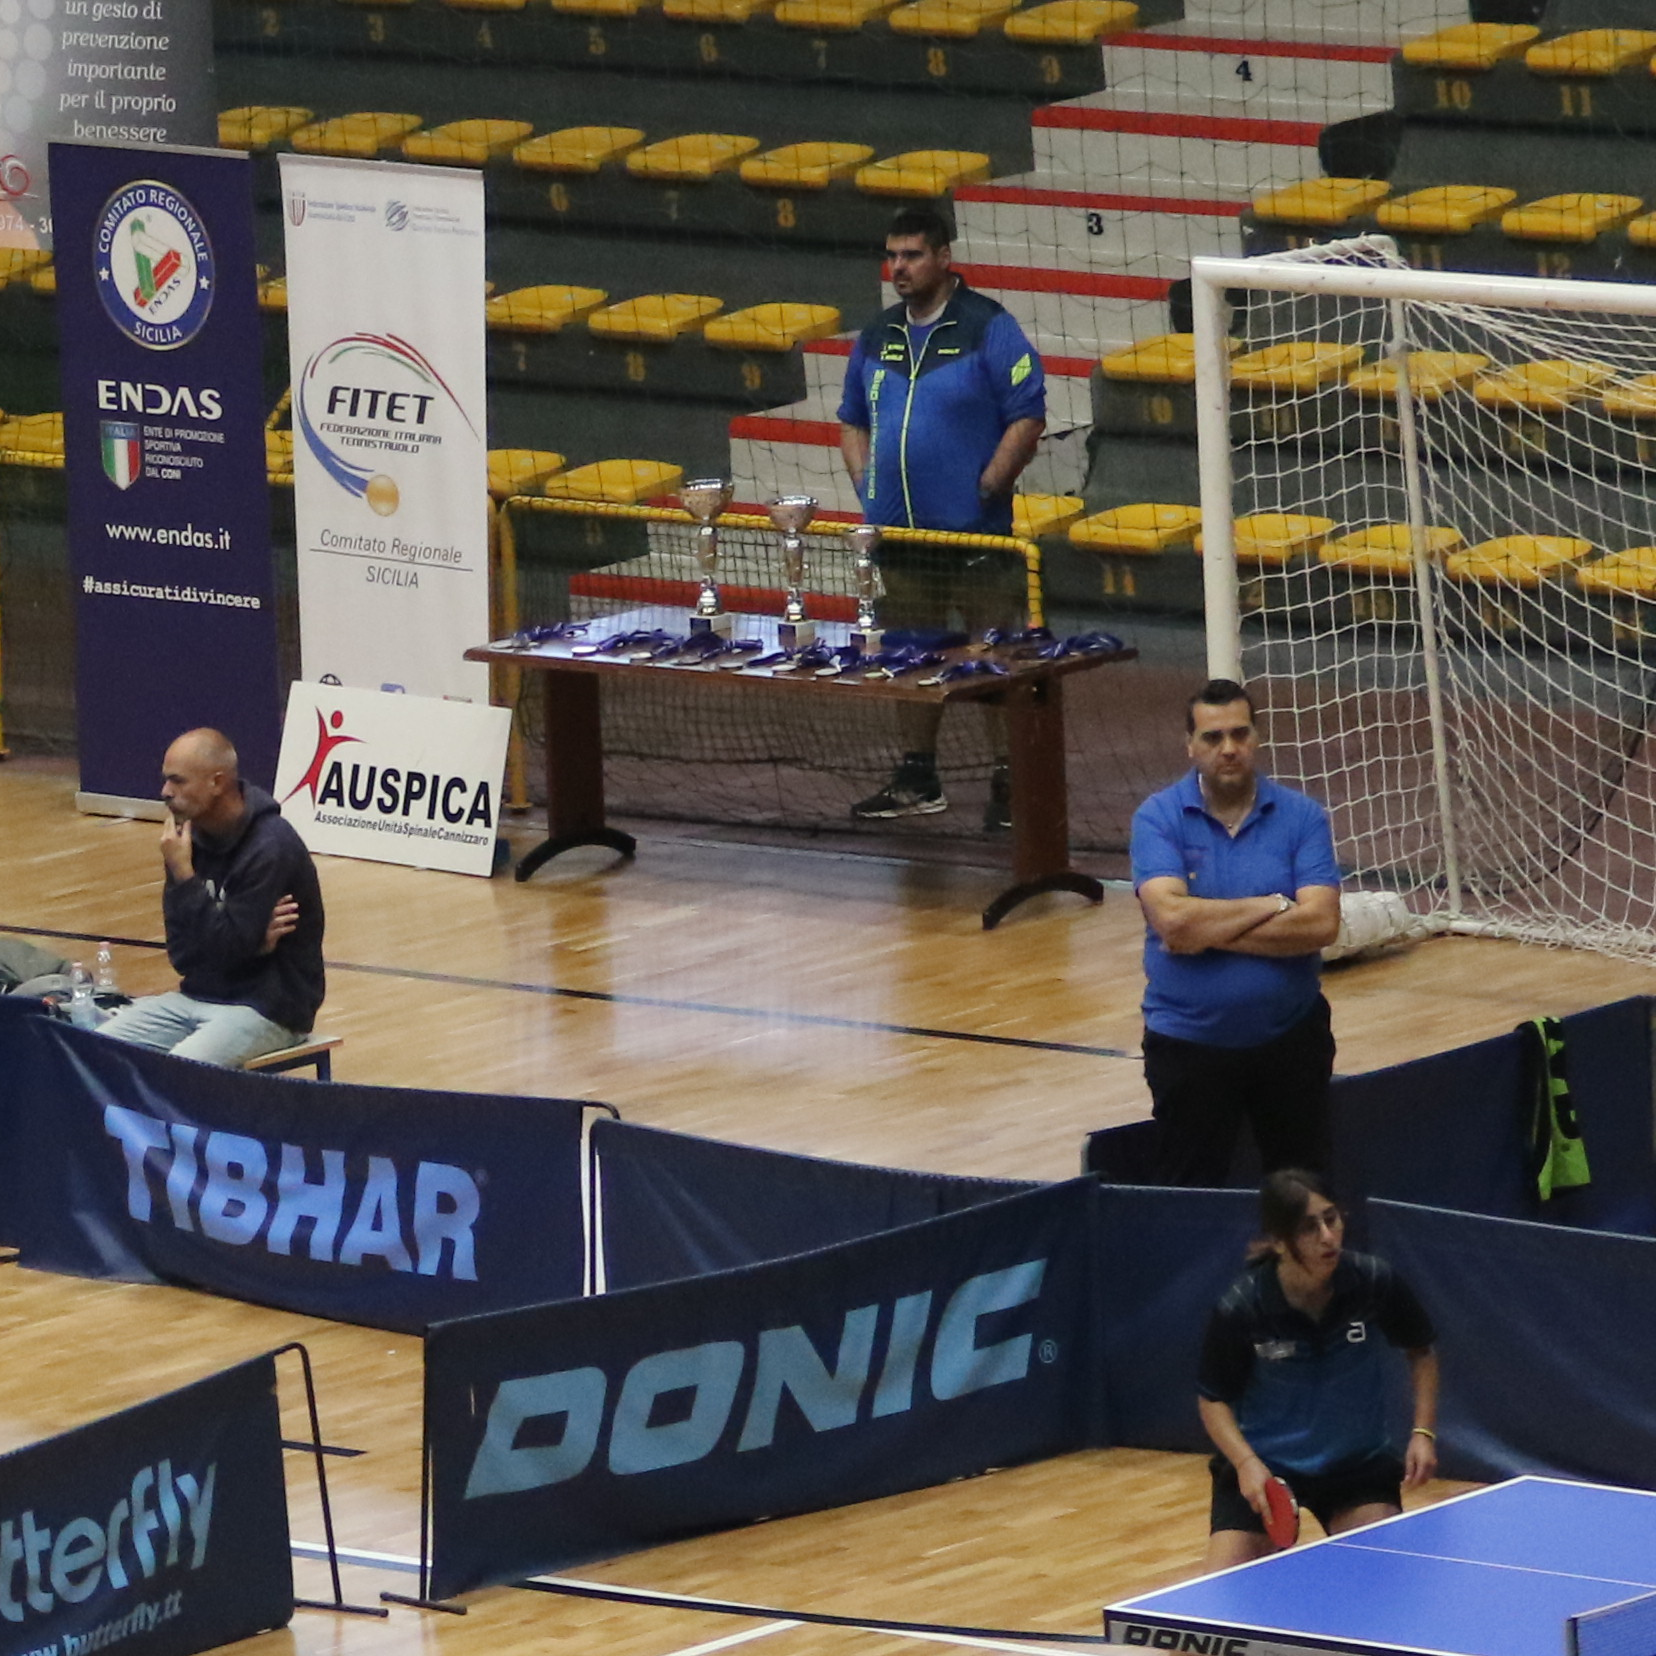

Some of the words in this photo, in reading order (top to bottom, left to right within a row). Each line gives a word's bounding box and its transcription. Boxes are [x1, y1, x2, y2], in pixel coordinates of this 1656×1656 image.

[92, 1, 138, 21] gesto
[143, 1, 163, 20] di
[62, 31, 170, 50] prevenzione
[68, 59, 166, 83] importante
[1236, 60, 1252, 81] 4
[59, 93, 89, 113] per
[95, 90, 106, 109] il
[111, 95, 176, 115] proprio
[74, 120, 167, 142] benessere
[98, 190, 146, 254] COMITATO
[150, 190, 208, 262] REGIONALE
[1087, 213, 1104, 235] 3
[147, 276, 182, 318] ENDAS
[134, 321, 183, 343] SICILIA
[97, 379, 223, 420] ENDAS
[327, 386, 434, 424] FITET
[143, 426, 163, 438] ENTE
[175, 429, 225, 443] PROMOZIONE
[320, 422, 389, 440] FEDERAZIONE
[392, 431, 442, 445] ITALIANA
[340, 436, 419, 454] TENNISTAVOLO
[105, 523, 230, 550] www.endas.it
[320, 529, 386, 555] Comitato
[391, 538, 463, 564] Regionale
[366, 565, 419, 589] SICILIA
[83, 576, 260, 609] #assicuratidivincere
[318, 762, 492, 828] AUSPICA
[104, 1104, 480, 1281] TIBHAR
[465, 1257, 1049, 1499] DONIC
